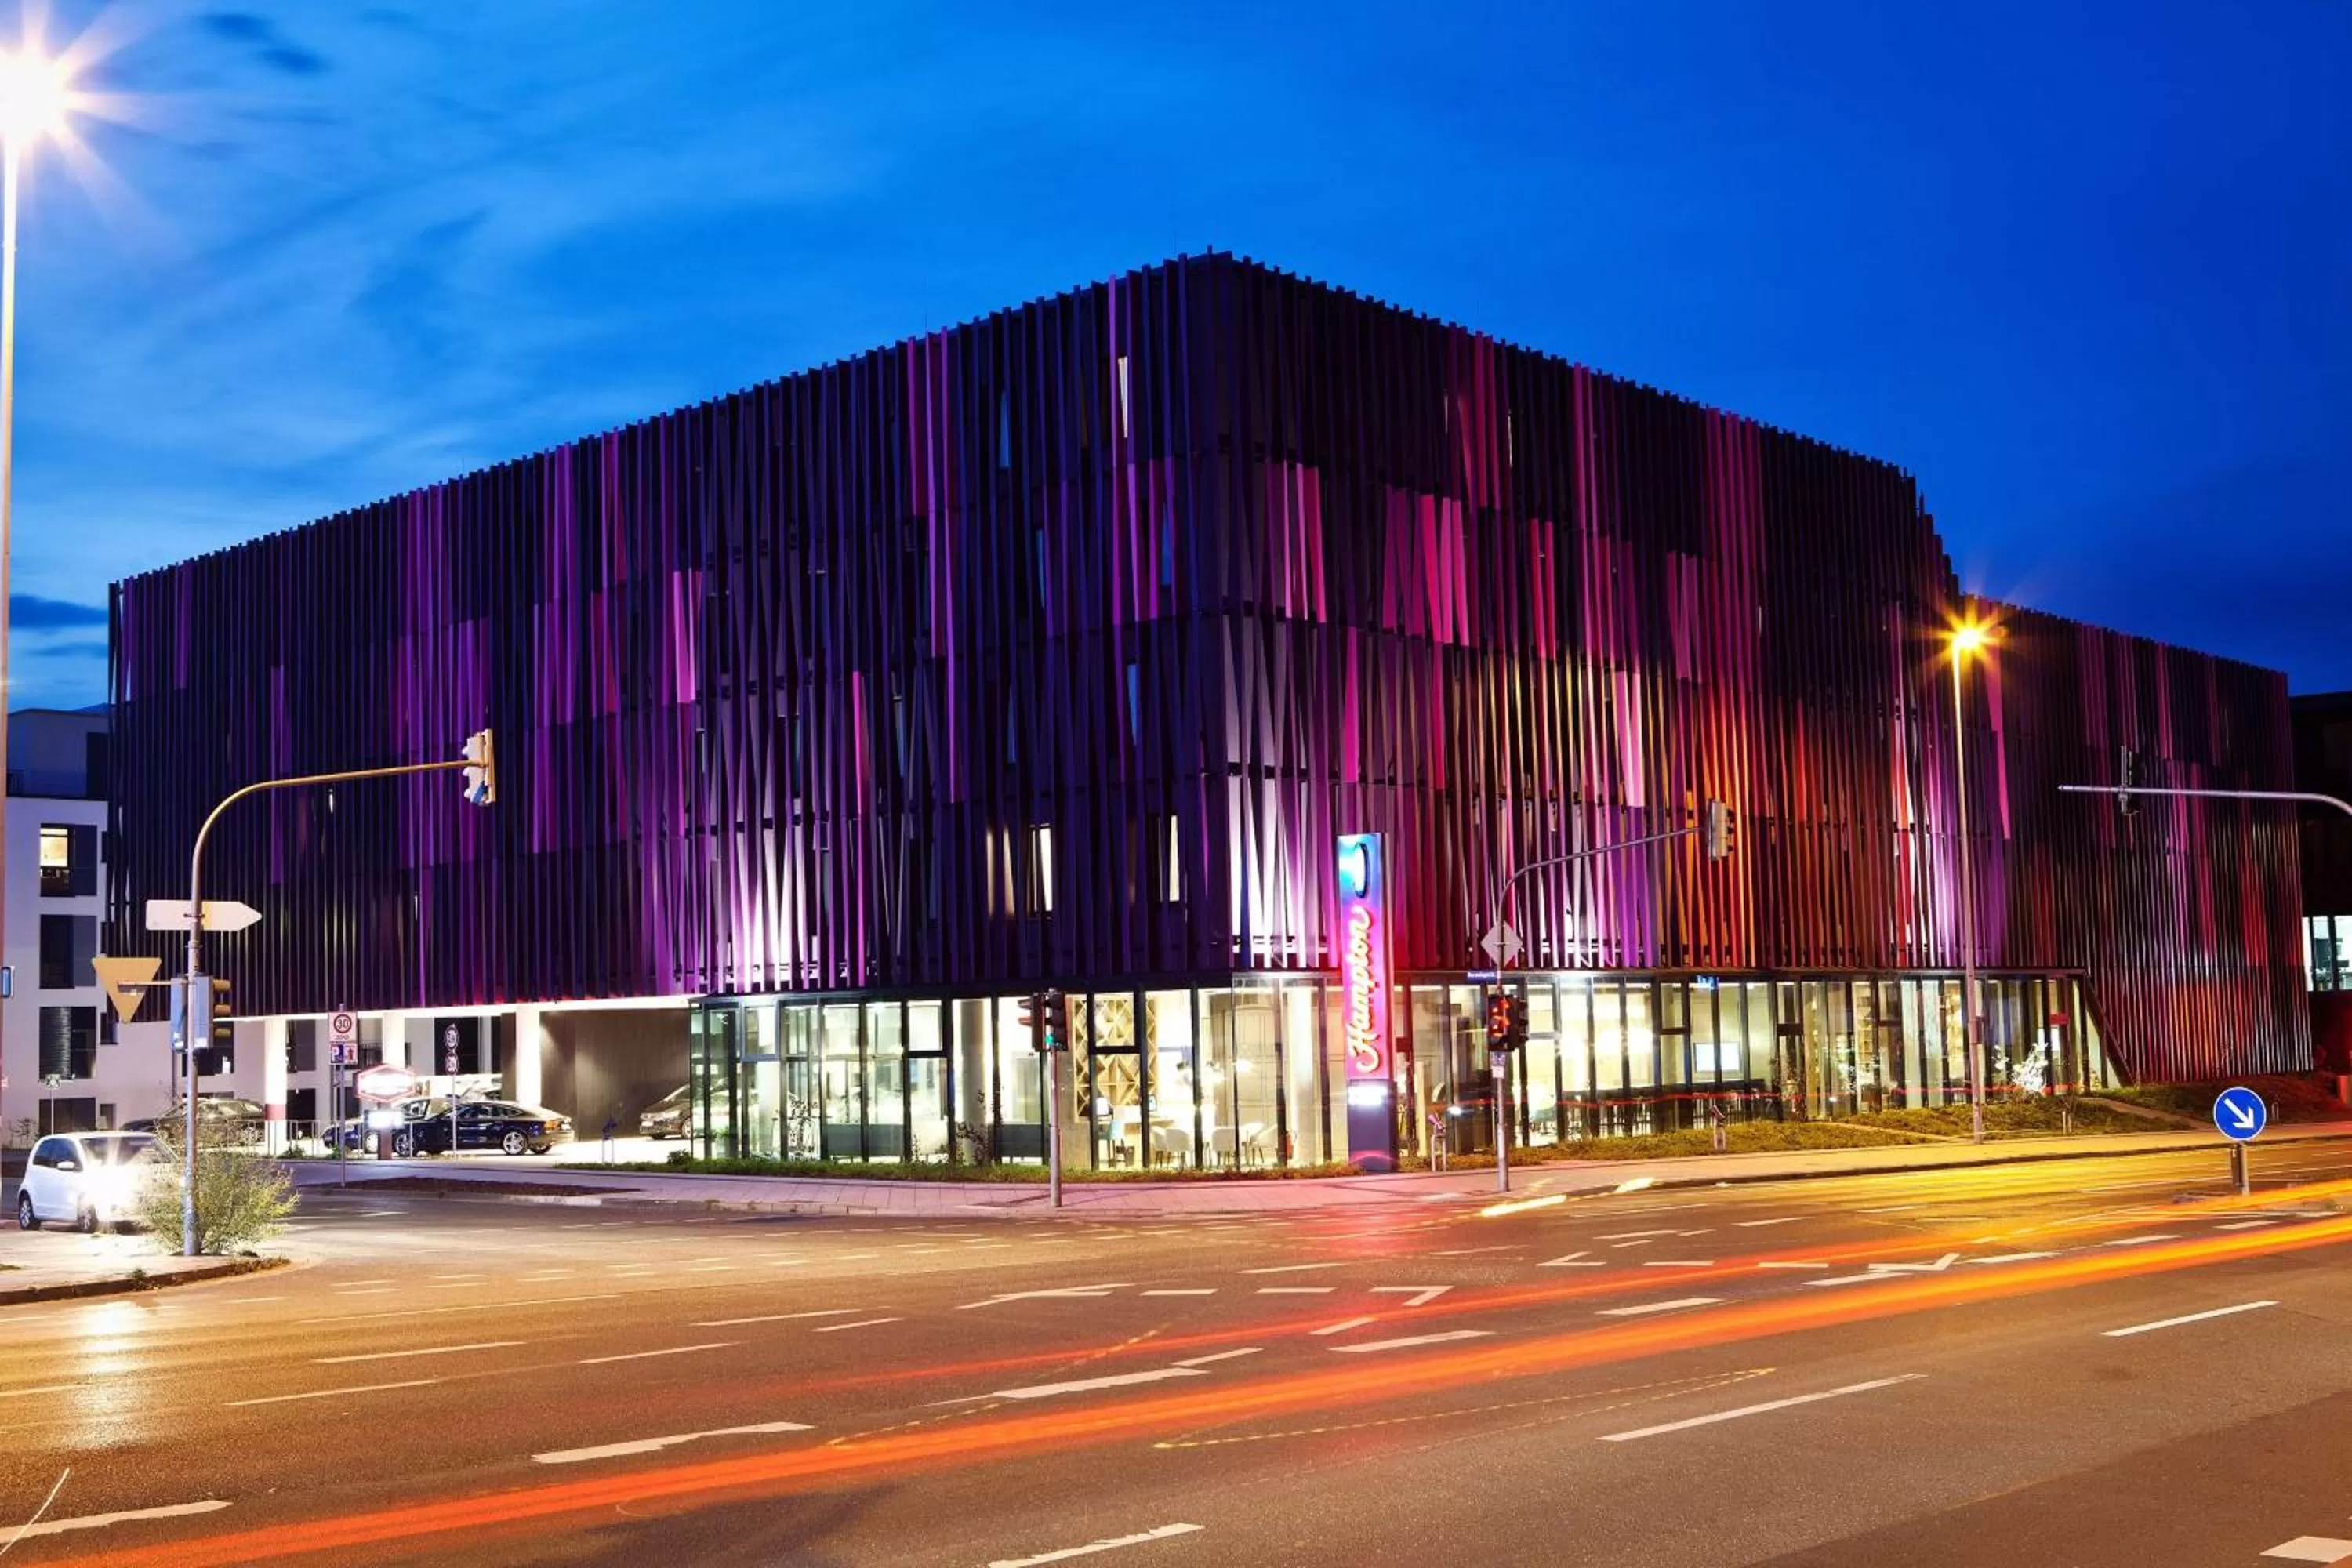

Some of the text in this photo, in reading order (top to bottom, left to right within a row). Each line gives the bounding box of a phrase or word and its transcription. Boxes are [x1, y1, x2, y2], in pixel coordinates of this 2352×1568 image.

[1345, 904, 1381, 1073] Hampton
[336, 1018, 349, 1029] 30
[332, 1047, 340, 1062] P
